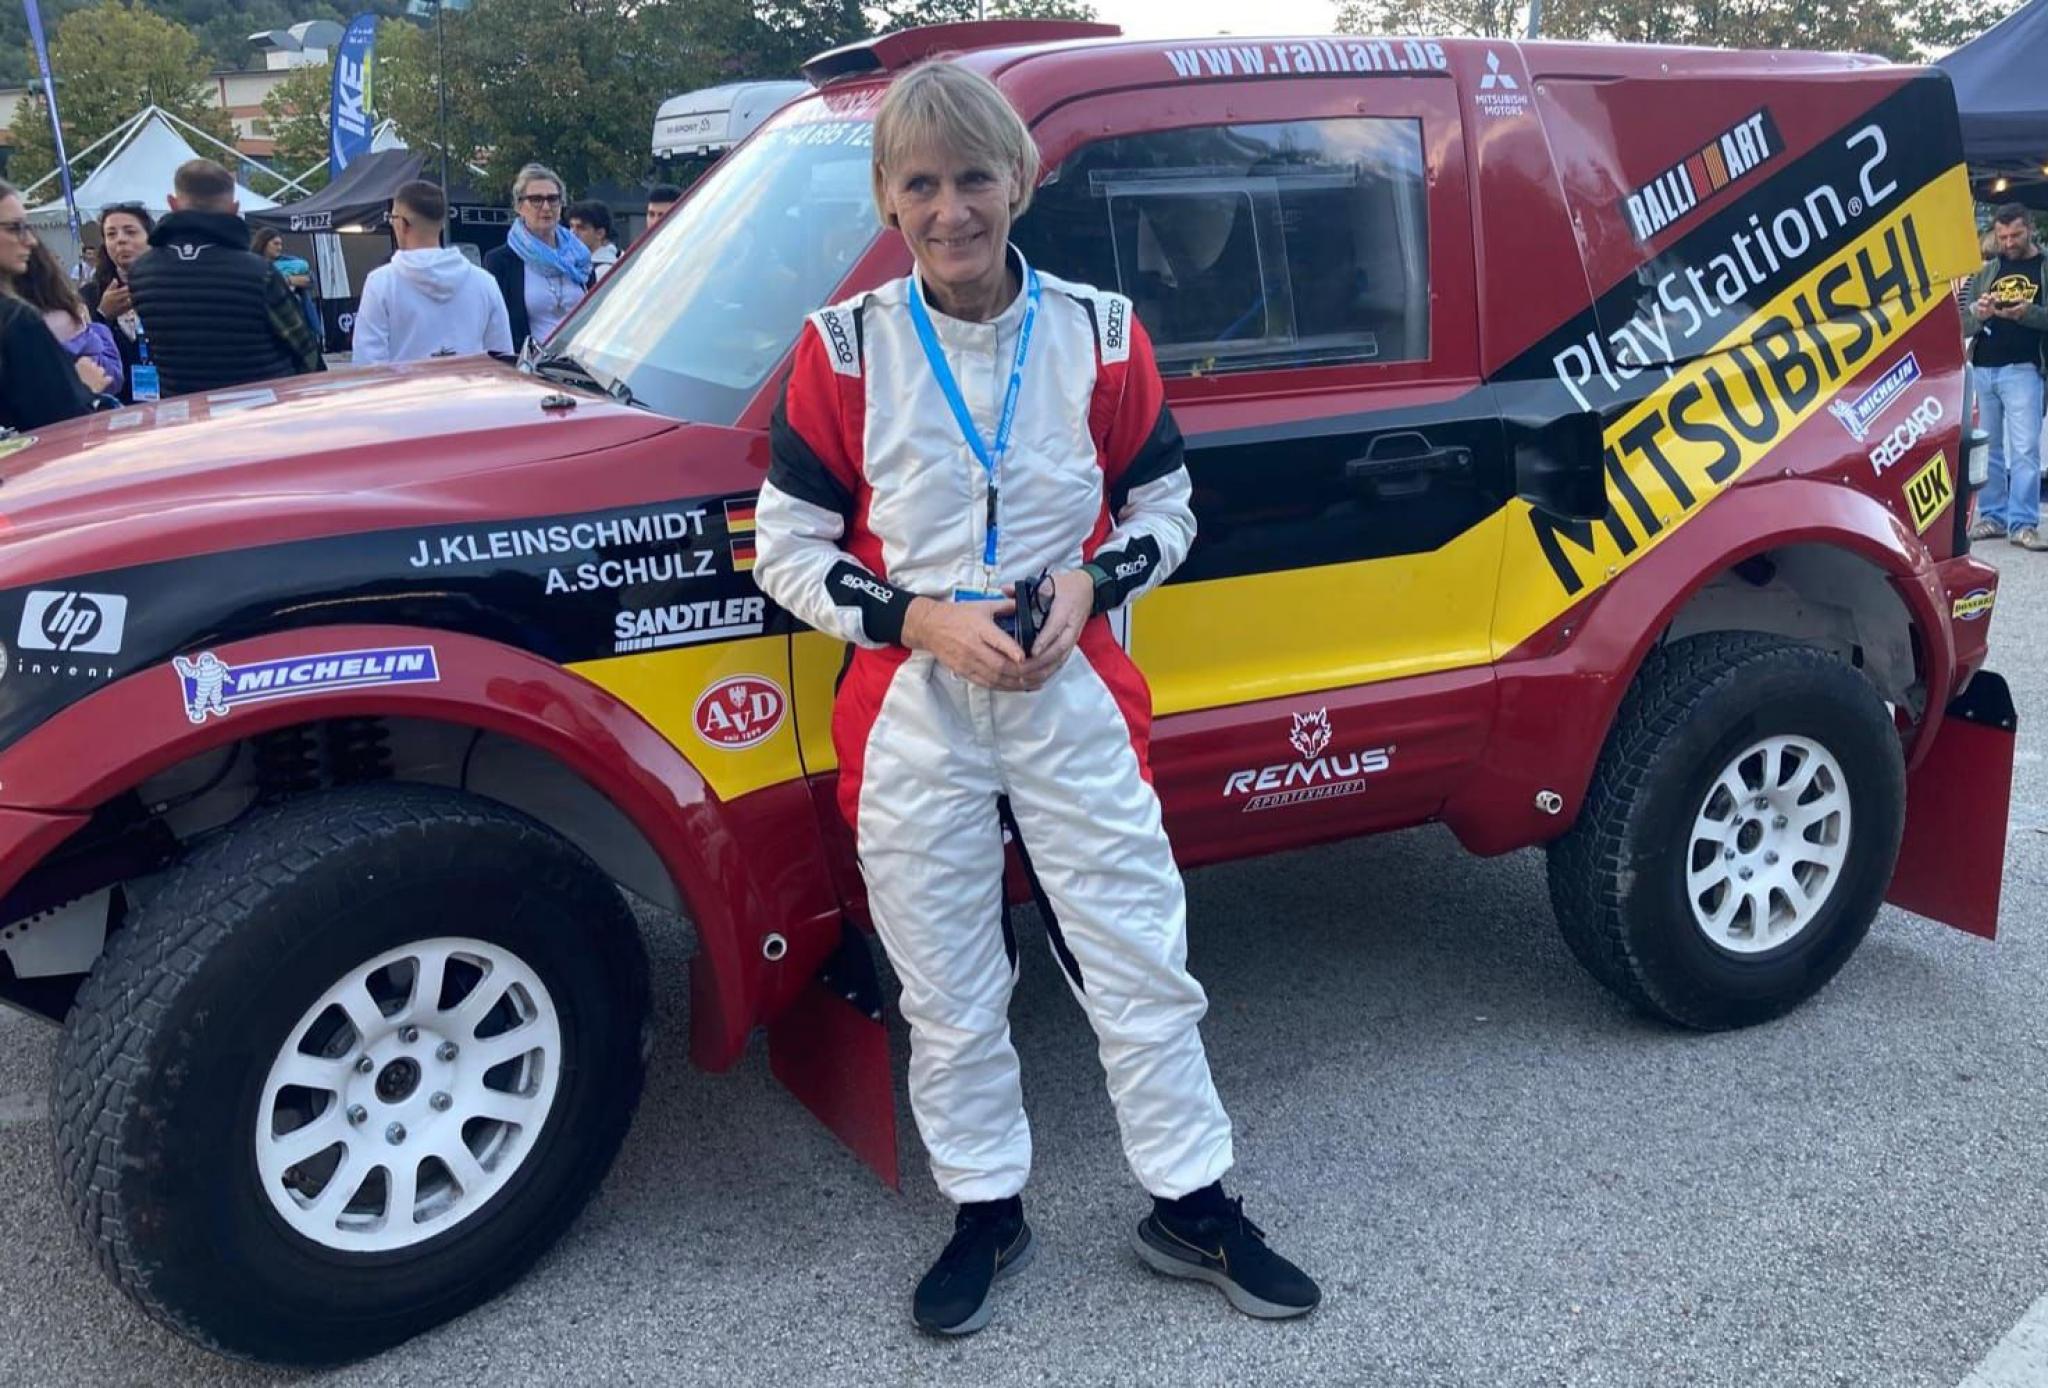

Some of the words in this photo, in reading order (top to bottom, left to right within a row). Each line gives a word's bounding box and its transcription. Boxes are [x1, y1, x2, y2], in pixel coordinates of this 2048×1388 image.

[1164, 39, 1447, 77] www.ralliart.de
[1474, 94, 1528, 105] MITSUBISHI
[1484, 105, 1523, 117] MOTORS
[1627, 163, 1697, 242] RALLI
[1720, 112, 1771, 180] ART
[825, 311, 854, 364] sparco
[1107, 298, 1122, 350] sparco
[1527, 213, 1932, 597] MITSUBISHI
[1857, 358, 1915, 419] MICHELIN
[1868, 395, 1944, 477] RECARO
[409, 508, 707, 569] J.KLEINSCHMIDT
[545, 549, 717, 596] A.SCHULZ
[841, 573, 894, 600] sparco
[47, 591, 97, 652] hp
[613, 596, 766, 639] SANDTLER
[17, 657, 114, 679] invent
[235, 653, 426, 692] MICHELIN
[1222, 747, 1391, 797] REMUS
